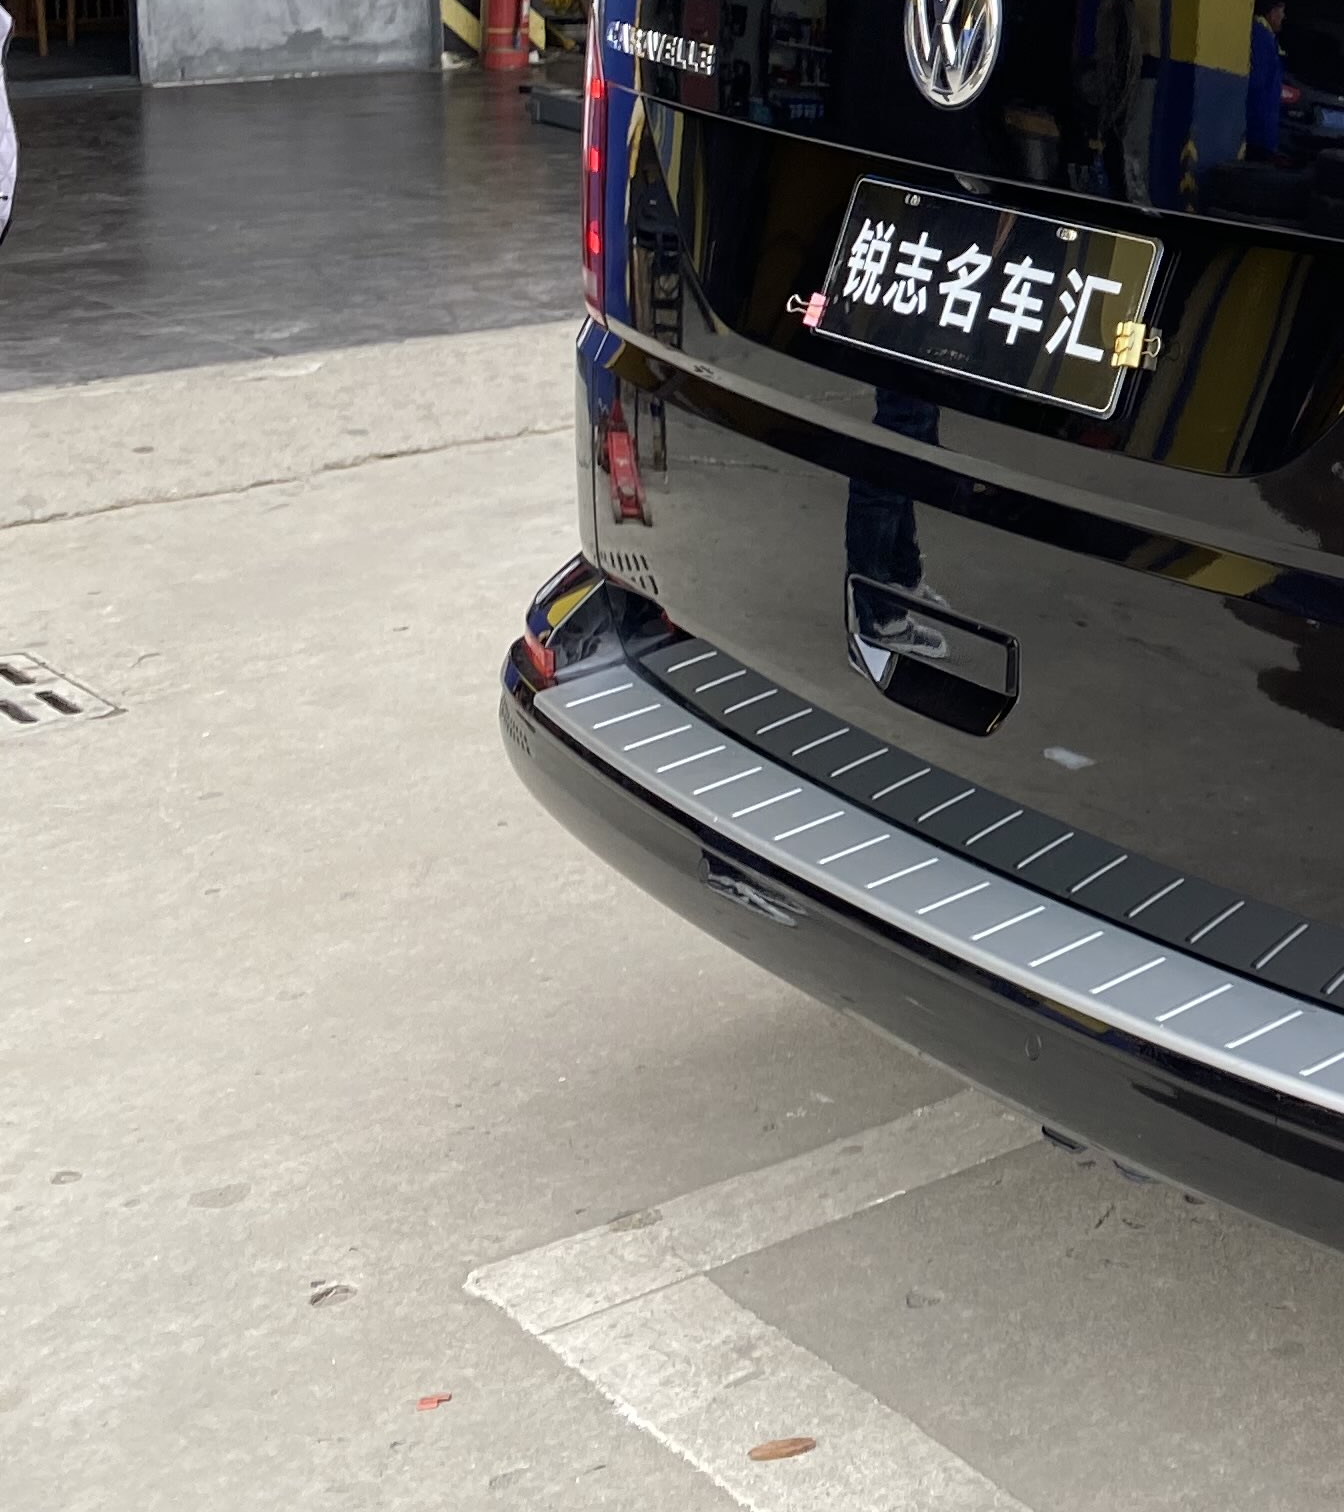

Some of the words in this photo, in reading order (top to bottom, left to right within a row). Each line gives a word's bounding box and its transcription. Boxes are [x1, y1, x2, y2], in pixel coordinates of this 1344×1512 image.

[842, 217, 1123, 363] 锐志名车汇
